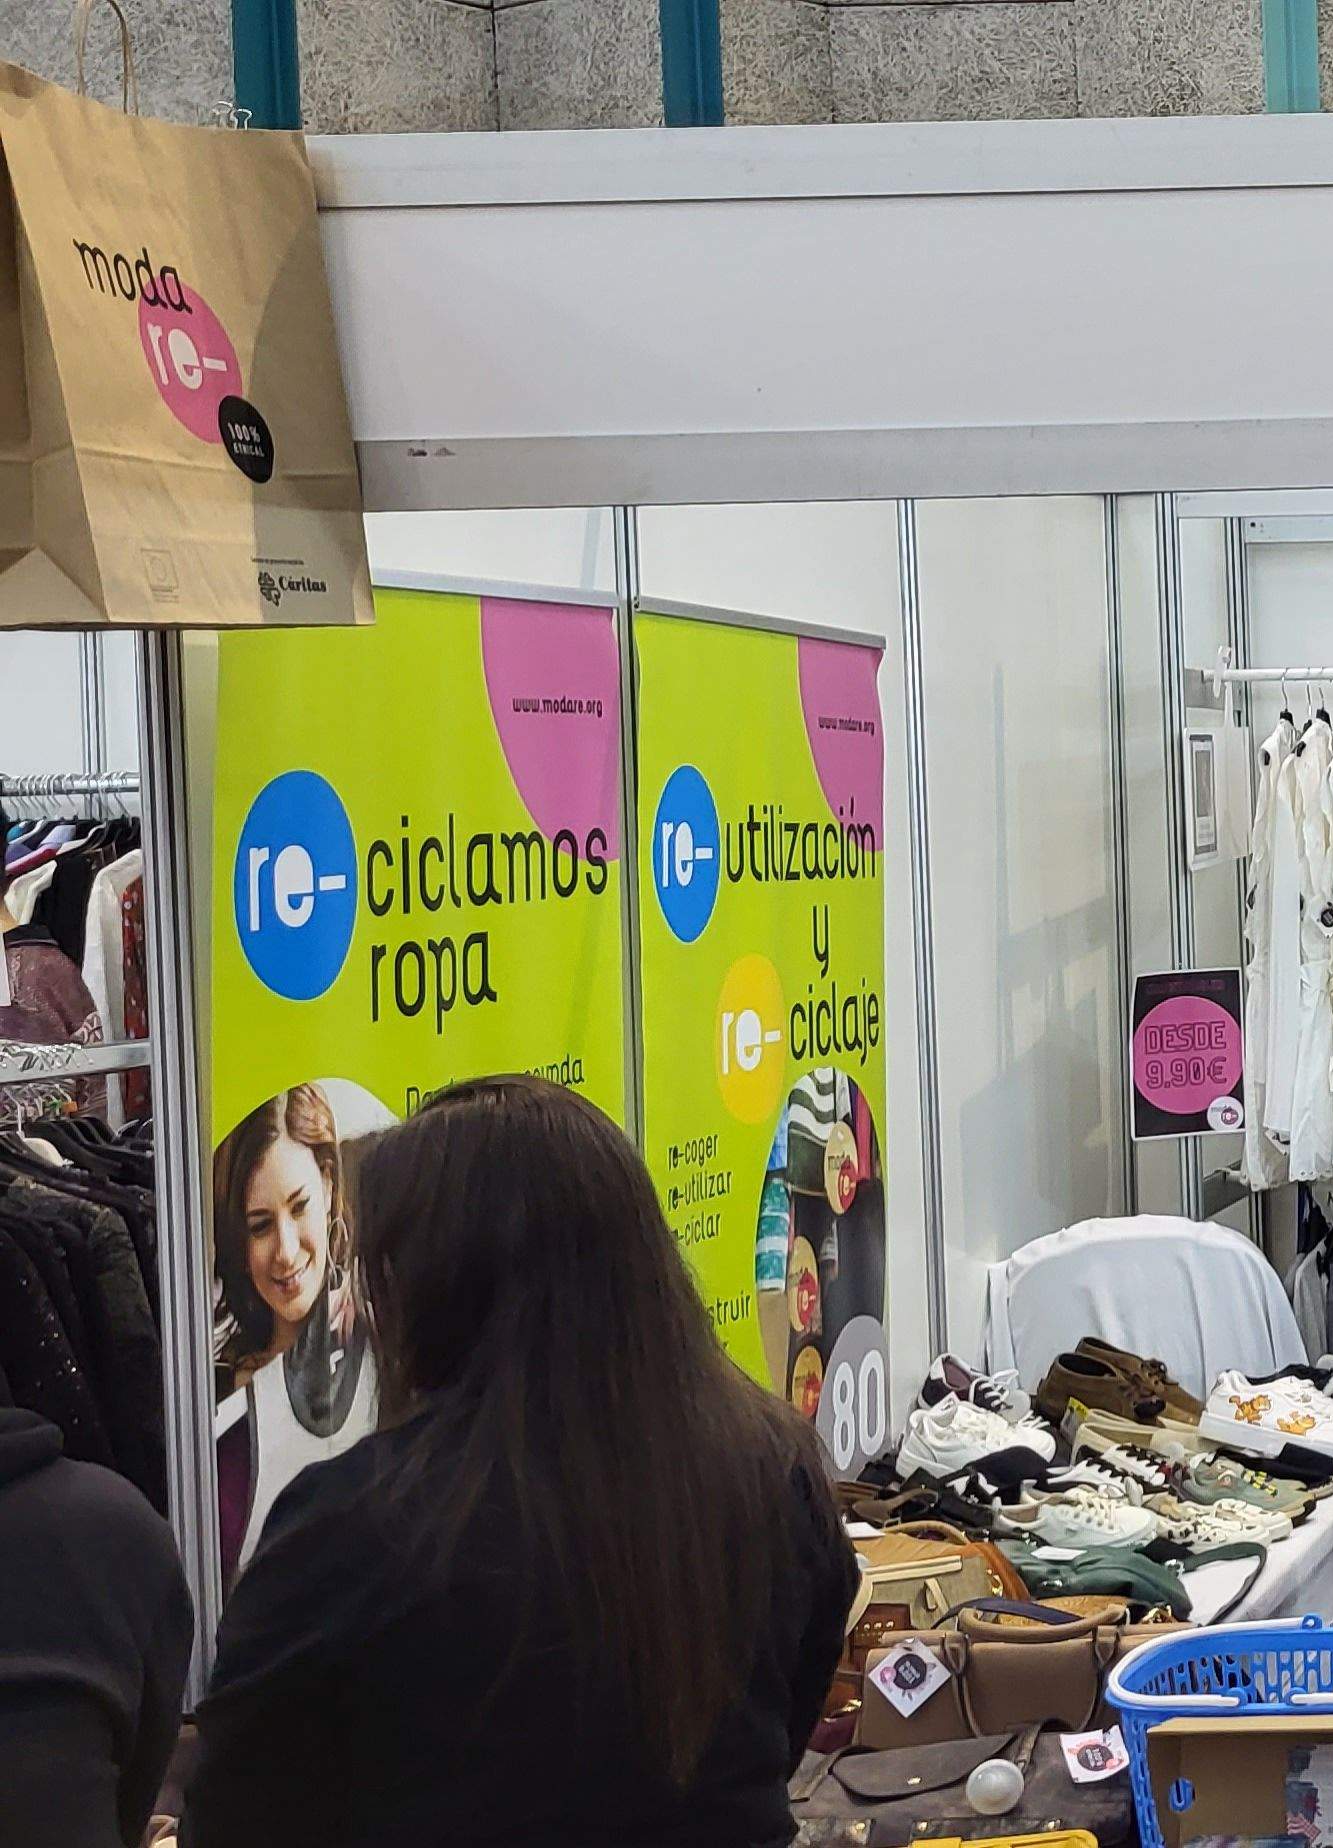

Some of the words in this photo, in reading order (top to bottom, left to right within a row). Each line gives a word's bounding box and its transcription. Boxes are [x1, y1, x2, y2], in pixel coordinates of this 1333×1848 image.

[72, 238, 193, 315] moda
[146, 322, 228, 390] re-
[227, 422, 261, 443] 100%
[512, 696, 603, 718] www.modare.org
[248, 844, 347, 932] re-
[366, 812, 609, 917] ciclamos
[661, 820, 714, 888] re-
[725, 797, 876, 883] utilización
[812, 903, 830, 979] y
[370, 930, 498, 1035] ropa
[721, 1008, 783, 1075] re-
[789, 977, 880, 1066] ciclaje
[1144, 1020, 1227, 1055] DESDE
[1145, 1056, 1228, 1090] 9.90€
[667, 1134, 719, 1172] re-coger
[667, 1171, 733, 1213] re-utilizar
[832, 1348, 887, 1472] 80
